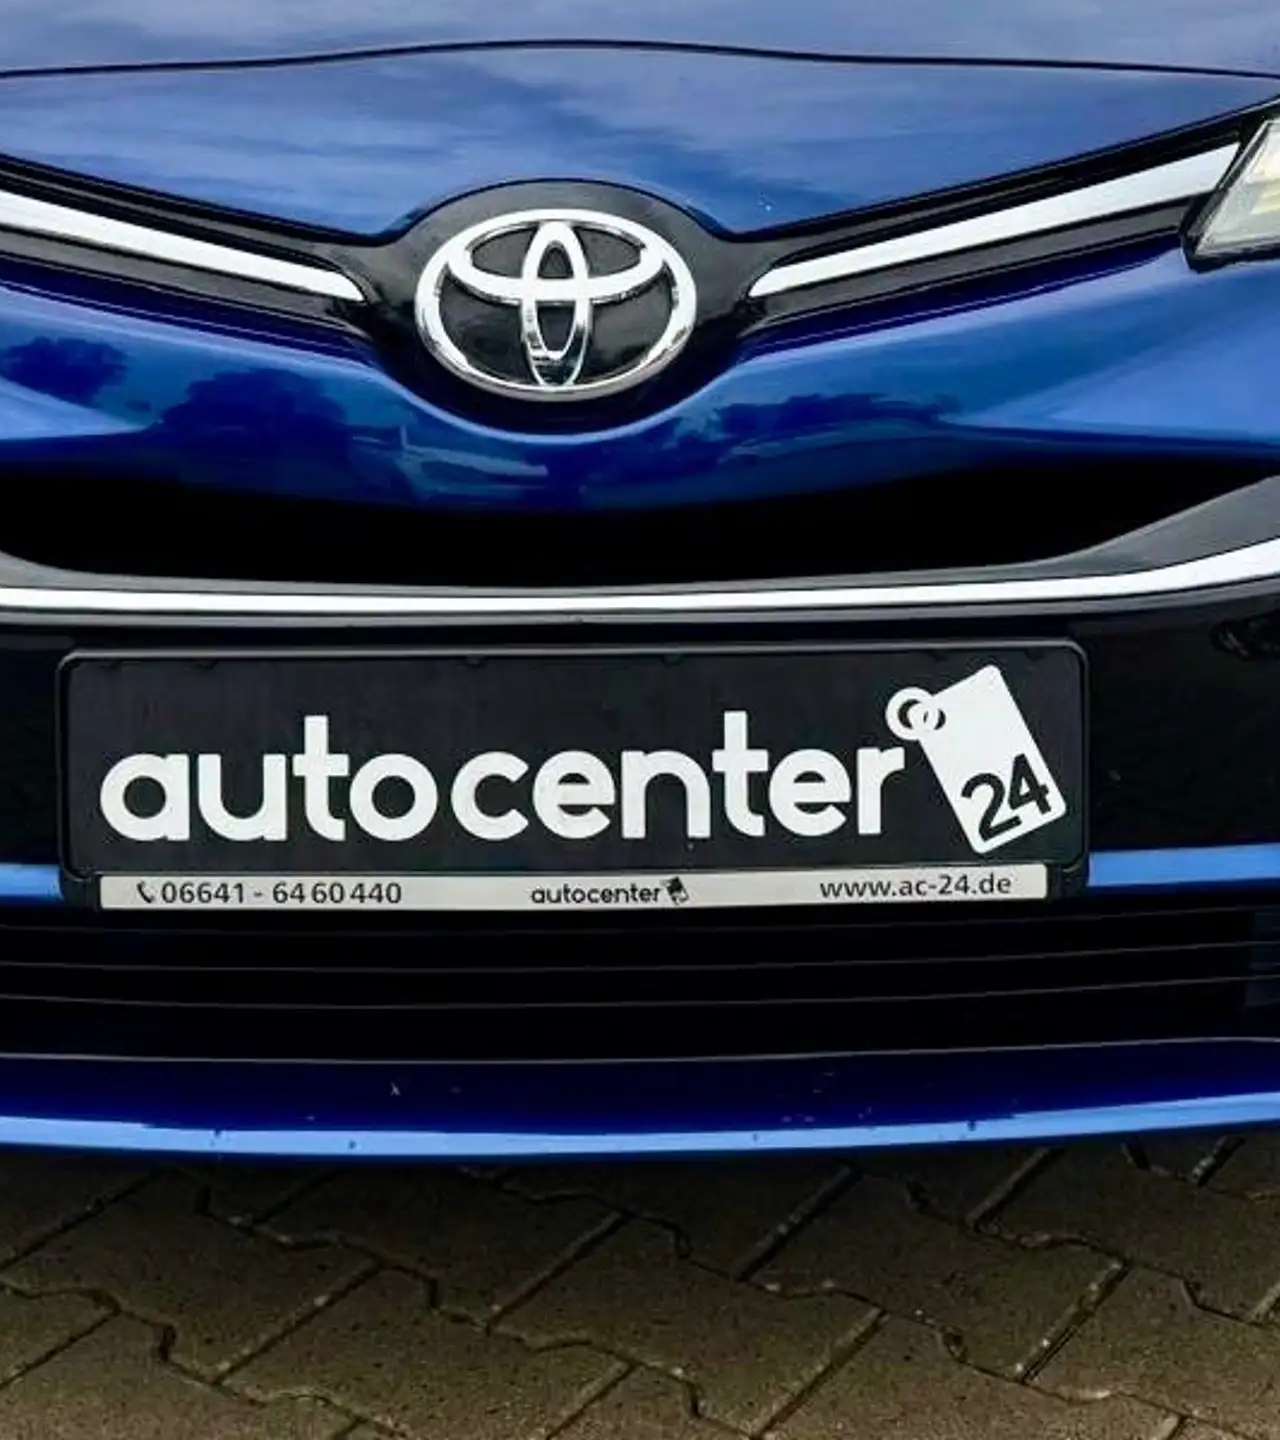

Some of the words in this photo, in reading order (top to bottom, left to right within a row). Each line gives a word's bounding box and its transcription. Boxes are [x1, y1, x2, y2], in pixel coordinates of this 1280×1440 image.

[961, 753, 1051, 842] 24
[531, 883, 663, 903] autocenter
[819, 872, 1012, 899] www.ac-24.de
